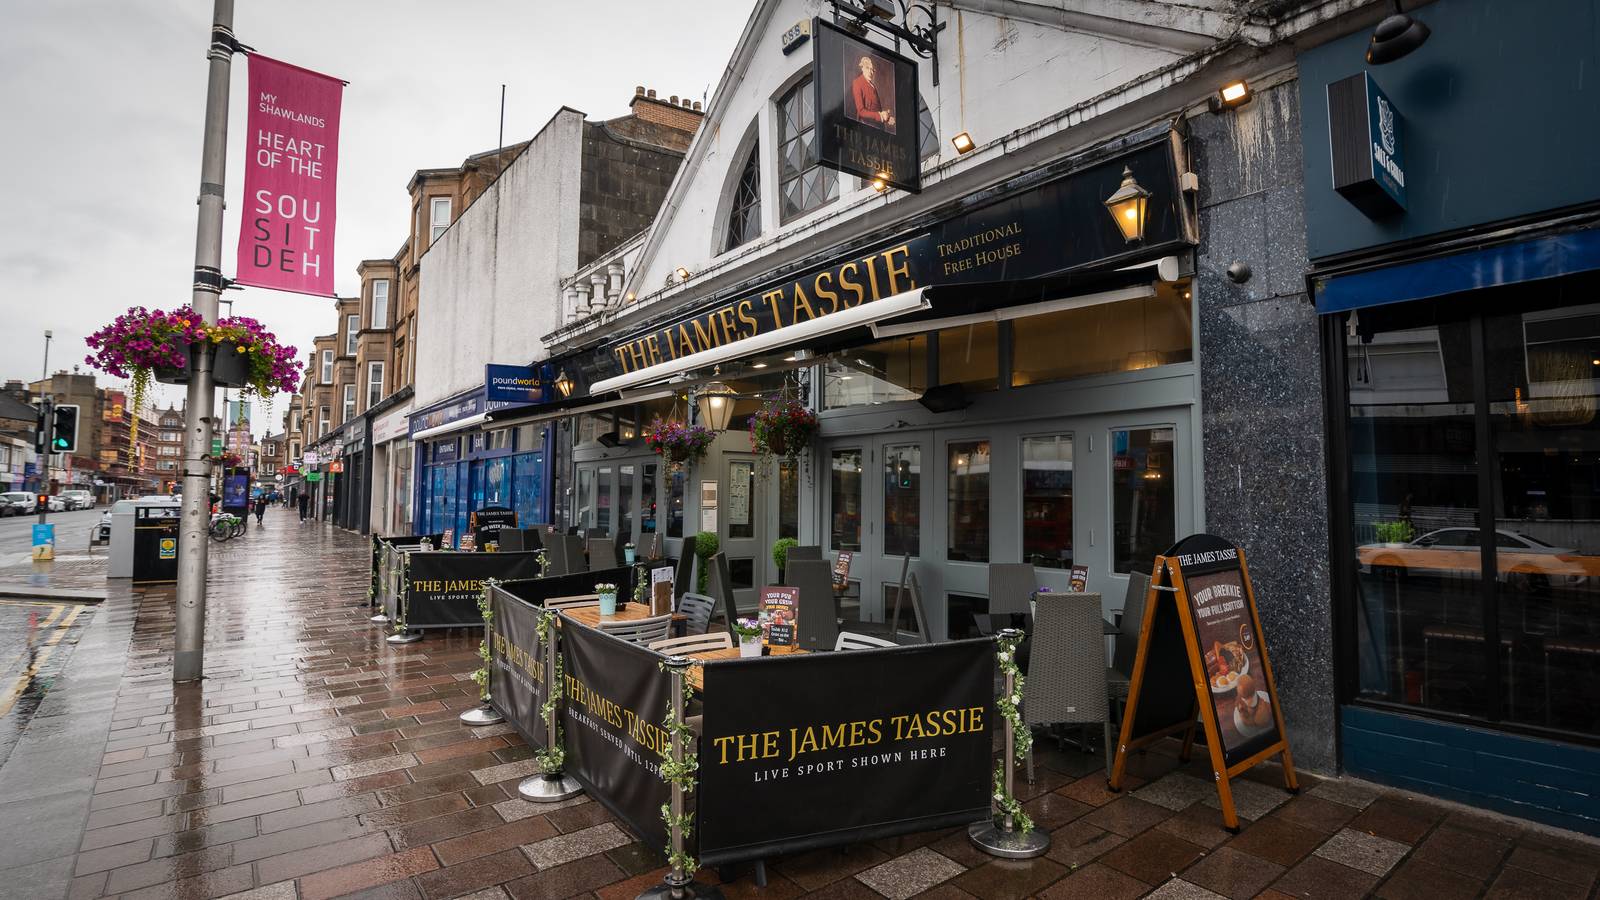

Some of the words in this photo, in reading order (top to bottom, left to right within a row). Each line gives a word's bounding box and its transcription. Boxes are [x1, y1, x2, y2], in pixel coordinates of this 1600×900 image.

[260, 92, 277, 104] MY
[259, 102, 325, 128] SHAWLANDS
[258, 129, 325, 160] HEART
[833, 123, 863, 146] THE
[865, 135, 906, 160] JAMES
[257, 149, 282, 168] OF
[287, 155, 322, 180] THE
[848, 148, 894, 175] TASSIE
[937, 221, 1022, 258] TRADITIONAL
[943, 256, 974, 276] FREE
[975, 243, 1022, 270] HOUSE
[614, 338, 665, 375] THE
[663, 299, 759, 361] JAMES
[764, 245, 917, 331] TASSIE
[1177, 554, 1194, 567] THE
[1193, 550, 1216, 565] JAMES
[1215, 548, 1238, 561] TASSIE
[413, 580, 442, 592] THE
[444, 579, 485, 594] JAMES
[1193, 587, 1214, 607] YOUR
[1212, 584, 1242, 598] BREKKIE
[1196, 606, 1212, 619] YOUR
[1211, 603, 1224, 616] FULL
[1222, 599, 1245, 613] SCOTTISH
[493, 631, 506, 655] THE
[505, 640, 523, 668] JAMES
[523, 649, 545, 684] TASSIE
[564, 673, 587, 705] THE
[586, 687, 623, 729] JAMES
[623, 709, 669, 757] TASSIE
[568, 706, 599, 732] BREAKFAST
[600, 727, 623, 749] SERVED
[624, 743, 642, 765] UNTIL
[713, 730, 780, 765] THE
[787, 718, 883, 762] JAMES
[891, 706, 985, 740] TASSIE
[754, 767, 790, 782] LIVE
[797, 759, 845, 776] SPORT
[851, 751, 903, 768] SHOWN
[909, 746, 947, 761] HERE
